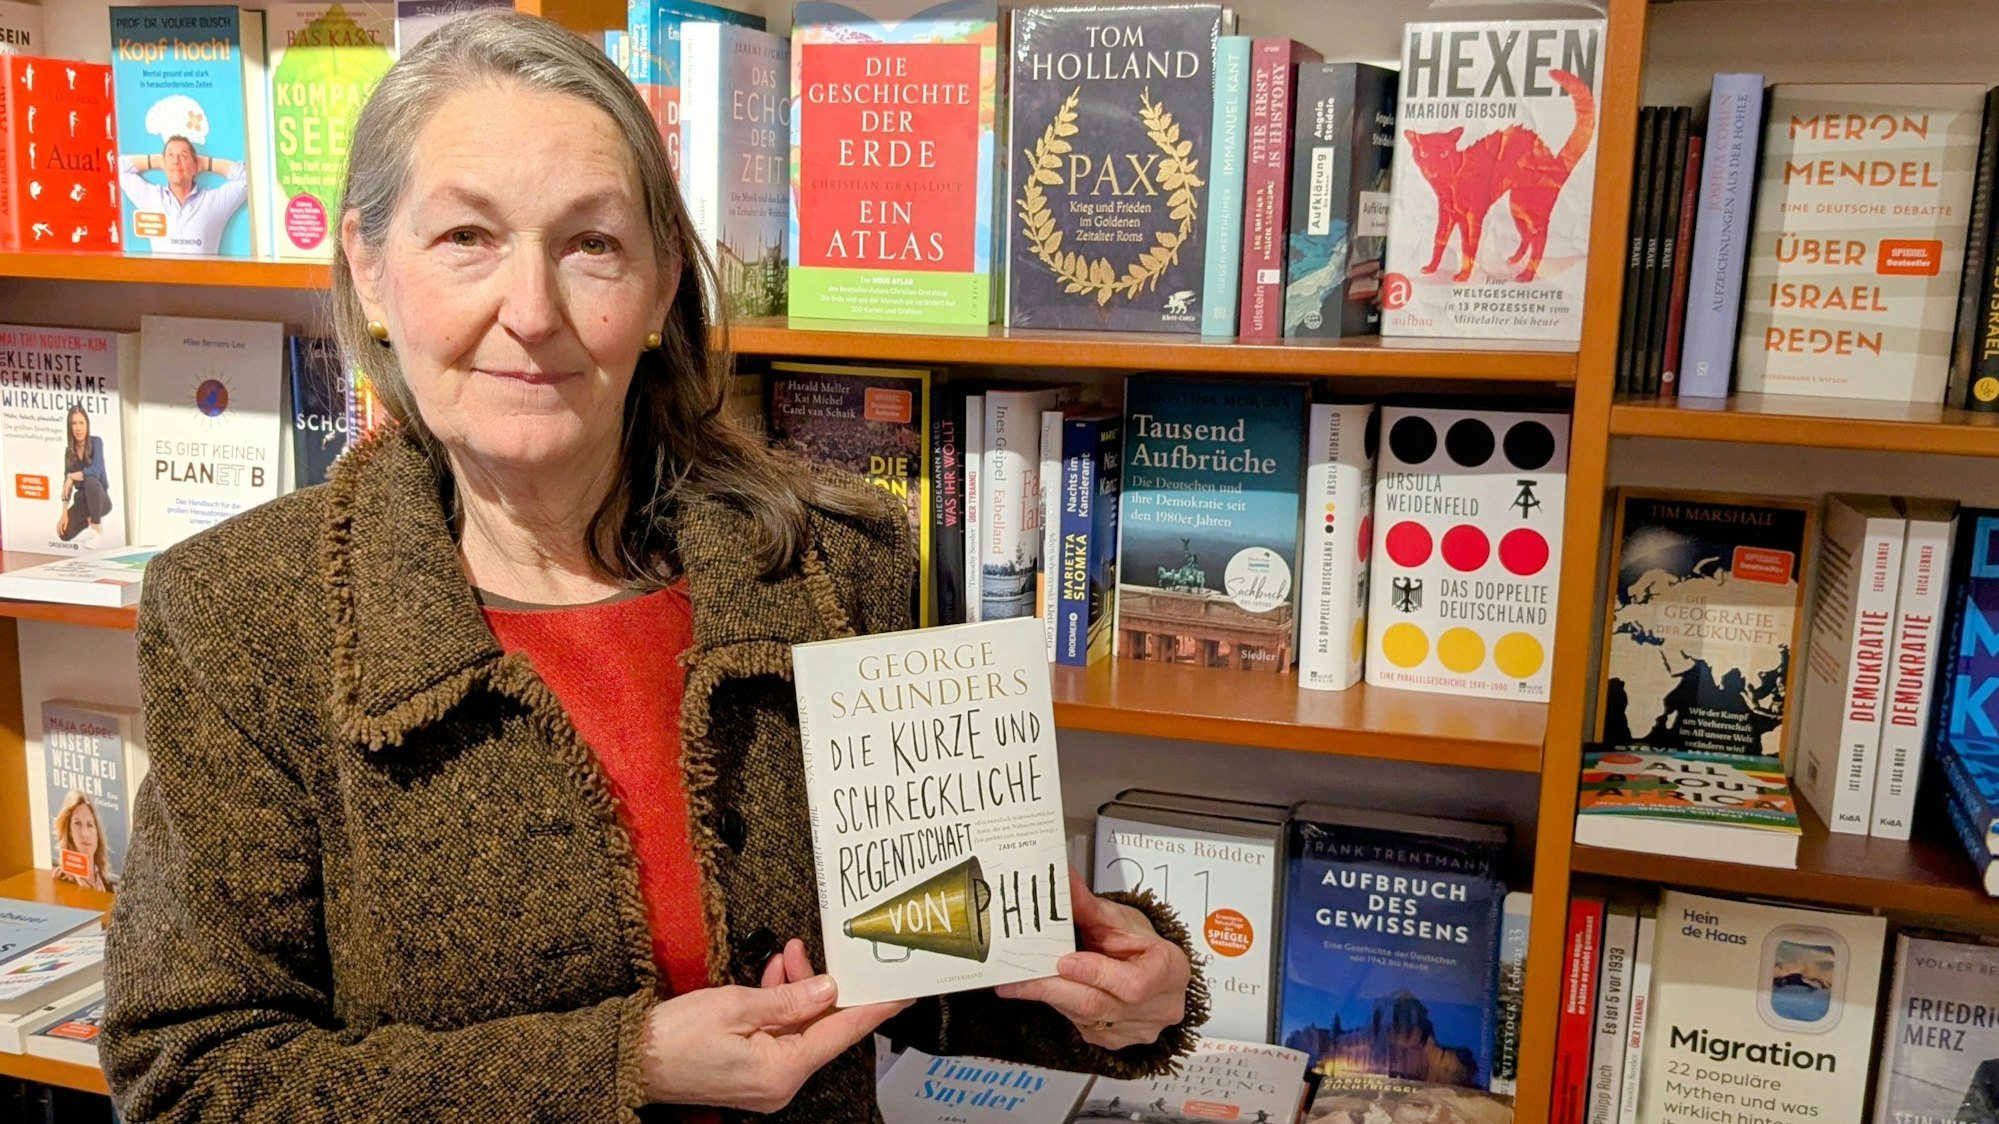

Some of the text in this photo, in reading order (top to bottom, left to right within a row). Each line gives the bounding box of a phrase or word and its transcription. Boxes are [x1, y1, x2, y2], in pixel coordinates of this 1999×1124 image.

[118, 36, 231, 65] Kopf hoch!
[286, 28, 381, 48] BAS KAST
[1086, 25, 1145, 48] TOM
[752, 66, 777, 89] DAS
[865, 57, 908, 78] DIE
[1032, 51, 1200, 82] HOLLAND
[1406, 28, 1599, 99] HEXEN
[808, 84, 971, 106] GESCHICHTE
[1255, 68, 1269, 118] REST
[732, 90, 791, 127] ECHO
[861, 111, 914, 133] DER
[1222, 54, 1240, 175] IMMANUEL KANT
[1268, 62, 1286, 168] IS HISTORY
[1313, 100, 1325, 138] Angela
[1324, 97, 1335, 141] Steidele
[1404, 102, 1517, 120] MARION GIBSON
[751, 128, 776, 149] DER
[1788, 113, 1930, 141] MERON
[46, 143, 101, 173] Aua!
[838, 140, 937, 168] ERDE
[1252, 125, 1267, 164] THE
[1708, 94, 1733, 212] JOSHUA COHEN
[741, 153, 784, 185] ZEIT
[1067, 153, 1160, 197] PAX
[1783, 160, 1939, 188] MENDEL
[811, 178, 964, 193] CHRISTIAN GRATALOUP
[1311, 154, 1327, 229] Aufklärung
[859, 199, 913, 225] EIN
[1069, 201, 1152, 216] Krieg und Frieden
[1712, 94, 1749, 314] AUFZEICHNUNGEN AUS DER HÖHLE
[1780, 202, 1953, 217] EINE DEUTSCHE DEBATTE
[1076, 230, 1144, 242] Zeitalter Roms
[1079, 216, 1141, 228] im Goldenen
[825, 228, 945, 262] ATLAS
[1775, 231, 1867, 266] ÜBER
[872, 276, 891, 286] NEUE
[892, 277, 914, 287] ATLAS
[1452, 288, 1564, 301] WELTGESCHICHTE
[1253, 285, 1265, 331] ullstein
[1443, 302, 1570, 315] in 13 PROZESSEN vom
[1769, 283, 1889, 312] ISRAEL
[1453, 314, 1560, 327] Mittelalter bis heute
[20, 332, 36, 348] THI
[40, 333, 108, 352] NGUYEN-KIM
[1764, 326, 1884, 357] REDEN
[7, 350, 83, 373] KLEINSTE
[0, 370, 106, 395] GEMEINSAME
[788, 380, 851, 394] Harald Meller
[1, 390, 109, 415] WIRKLICHKEIT
[782, 403, 857, 419] Carel van Schaik
[794, 392, 844, 406] Kai Michel
[1132, 413, 1246, 443] Tausend
[155, 440, 266, 461] ES GIBT KEINEN
[1131, 443, 1277, 475] Aufbrüche
[155, 459, 265, 487] PLANET B
[870, 455, 909, 477] DIE
[932, 421, 943, 526] FRIEDEMANN KARIG
[942, 419, 958, 528] WAS IHR WOLLT
[992, 405, 1008, 556] Ines Geipel Fabelland
[1066, 456, 1079, 513] Nachts im
[1077, 452, 1091, 518] Kanzleramt
[1132, 475, 1243, 494] Die Deutschen und
[1386, 471, 1442, 493] URSULA
[1131, 491, 1247, 512] ihre Demokratie seit
[1386, 493, 1480, 517] WEIDENFELD
[1651, 505, 1776, 526] TIM MARSHALL
[1130, 508, 1233, 528] den 1980er Jahren
[1063, 533, 1075, 600] MARIETTA
[1073, 534, 1088, 601] SLOMKA
[1226, 576, 1287, 600] Sachbuch
[1440, 578, 1549, 604] DAS DOPPELTE
[1440, 599, 1547, 626] DEUTSCHLAND
[1664, 604, 1774, 629] GEOGRAFIE
[1655, 622, 1776, 645] DER ZUKUNFT
[858, 640, 997, 682] GEORGE
[1240, 648, 1277, 661] Siedler
[1849, 610, 1889, 723] DEMOKRATIE
[1891, 613, 1932, 727] DEMOKRATIE
[830, 667, 1030, 720] SAUNDERS
[49, 717, 115, 740] MAJA GÖPEL
[1688, 707, 1750, 722] Wie der Kampf
[50, 729, 101, 757] UNSERE
[830, 708, 1041, 777] DIE KURZE UND
[52, 748, 117, 780] WELT NEU
[53, 768, 103, 797] DENKEN
[832, 754, 1043, 835] SCHRECKLICHE
[998, 839, 1037, 851] ZADIE SMITH
[1106, 828, 1266, 866] Andreas Rödder
[1303, 839, 1491, 872] FRANK TRENTMANN
[838, 822, 975, 908] REGENTSCHAFT
[1320, 868, 1468, 903] AUFBRUCH
[888, 891, 953, 936] VON
[971, 862, 1069, 946] PHIL
[1368, 894, 1419, 917] DES
[1683, 908, 1719, 927] Hein
[1207, 928, 1250, 944] SPIEGEL
[1315, 907, 1470, 944] GEWISSENS
[1681, 923, 1748, 946] de Haas
[1323, 940, 1457, 966] Eine Geschichte der Deutschen
[1608, 946, 1625, 974] 1933
[935, 970, 984, 985] LUCHTERHAND
[1610, 975, 1622, 994] vor
[1501, 927, 1525, 1078] WITTSTOCK Februar 33
[1604, 1003, 1618, 1022] ist
[1607, 994, 1620, 1004] 5
[1602, 1022, 1617, 1036] Es
[1903, 1022, 1967, 1052] MERZ
[1201, 1041, 1299, 1062] KERMANI
[1669, 1024, 1837, 1074] Migration
[926, 1055, 1051, 1095] Timothy
[1598, 1064, 1613, 1087] Ruch
[1667, 1060, 1782, 1092] 22 populäre
[914, 1079, 1026, 1112] Snyder
[1151, 1081, 1236, 1099] JETZT
[1665, 1080, 1819, 1117] Mythen und was
